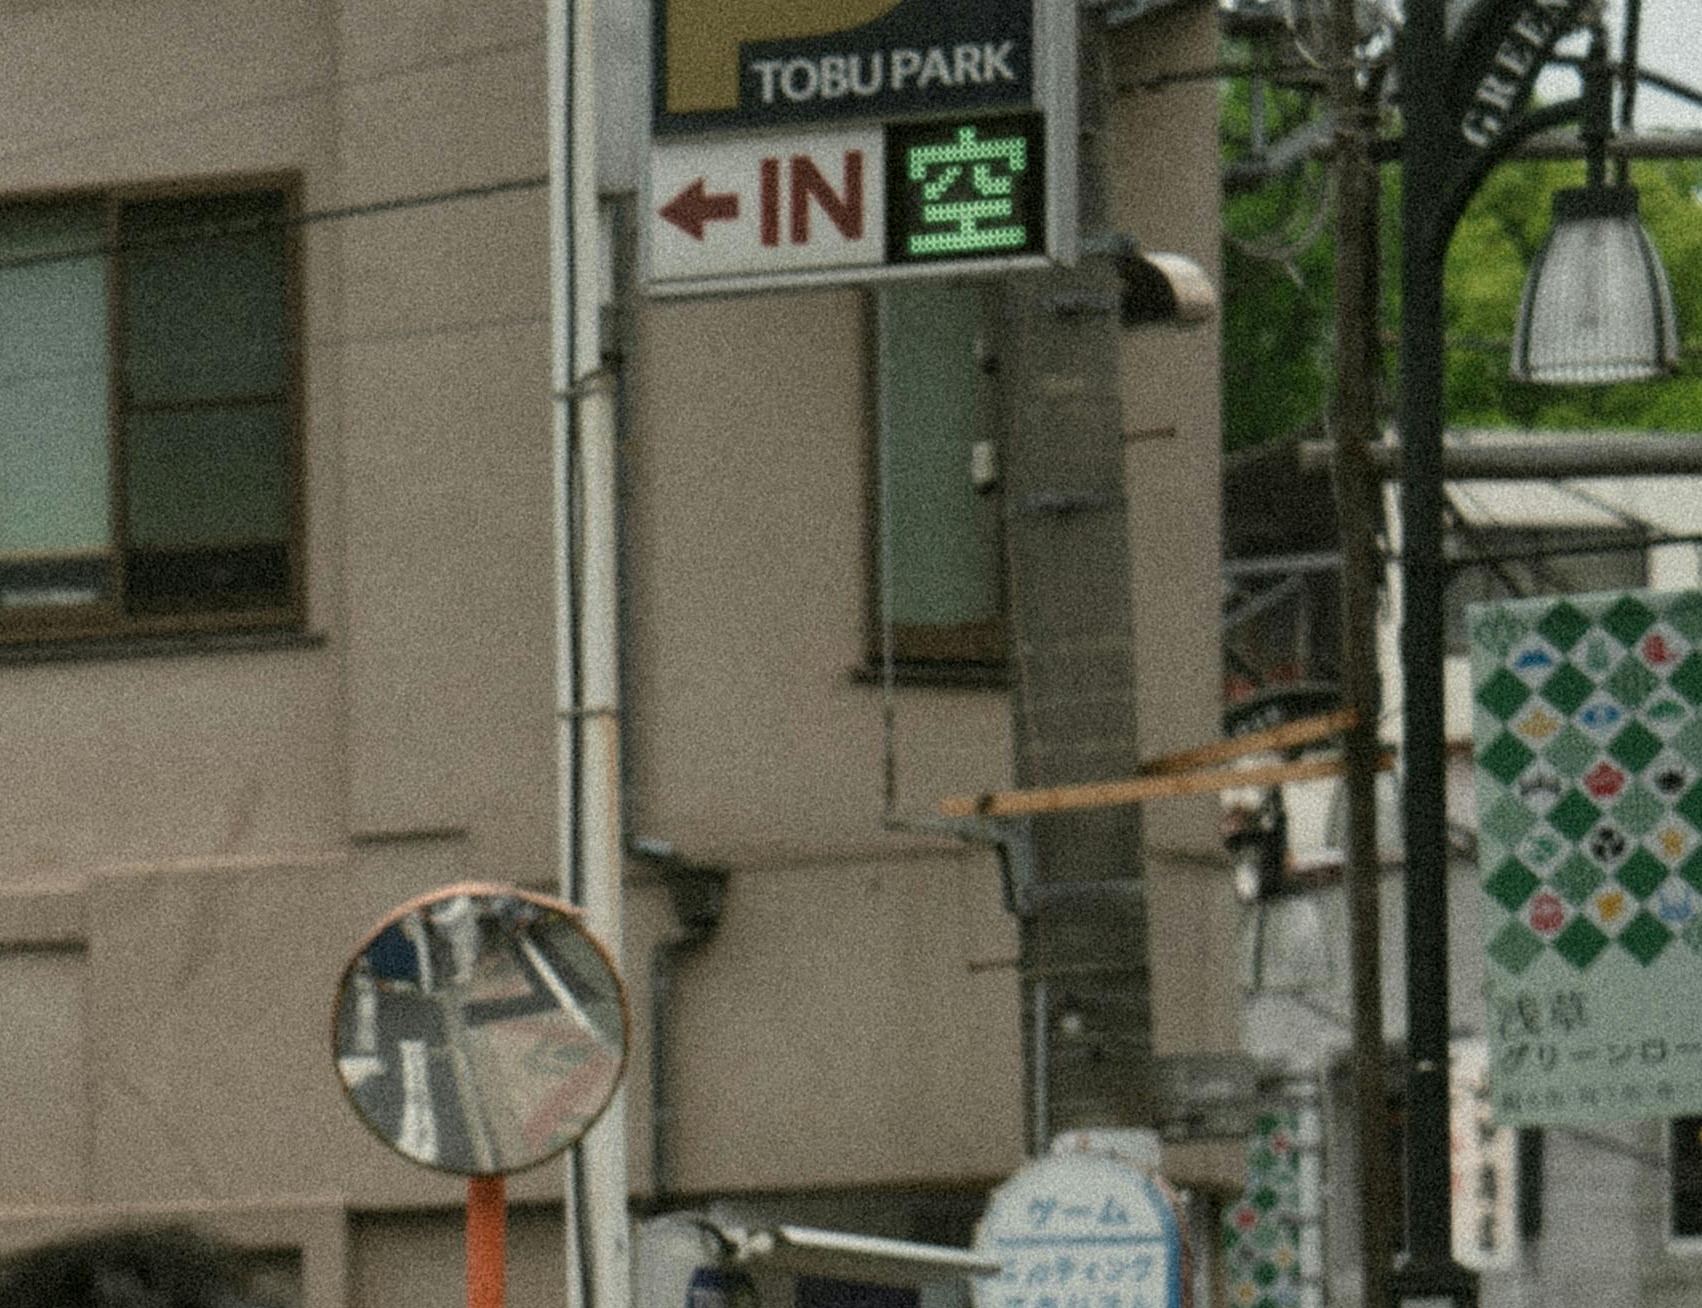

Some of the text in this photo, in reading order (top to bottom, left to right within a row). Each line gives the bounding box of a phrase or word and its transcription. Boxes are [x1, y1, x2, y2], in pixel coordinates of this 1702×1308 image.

[753, 41, 1017, 103] TOBU PARK
[759, 149, 865, 248] IN
[908, 126, 1027, 256] 空
